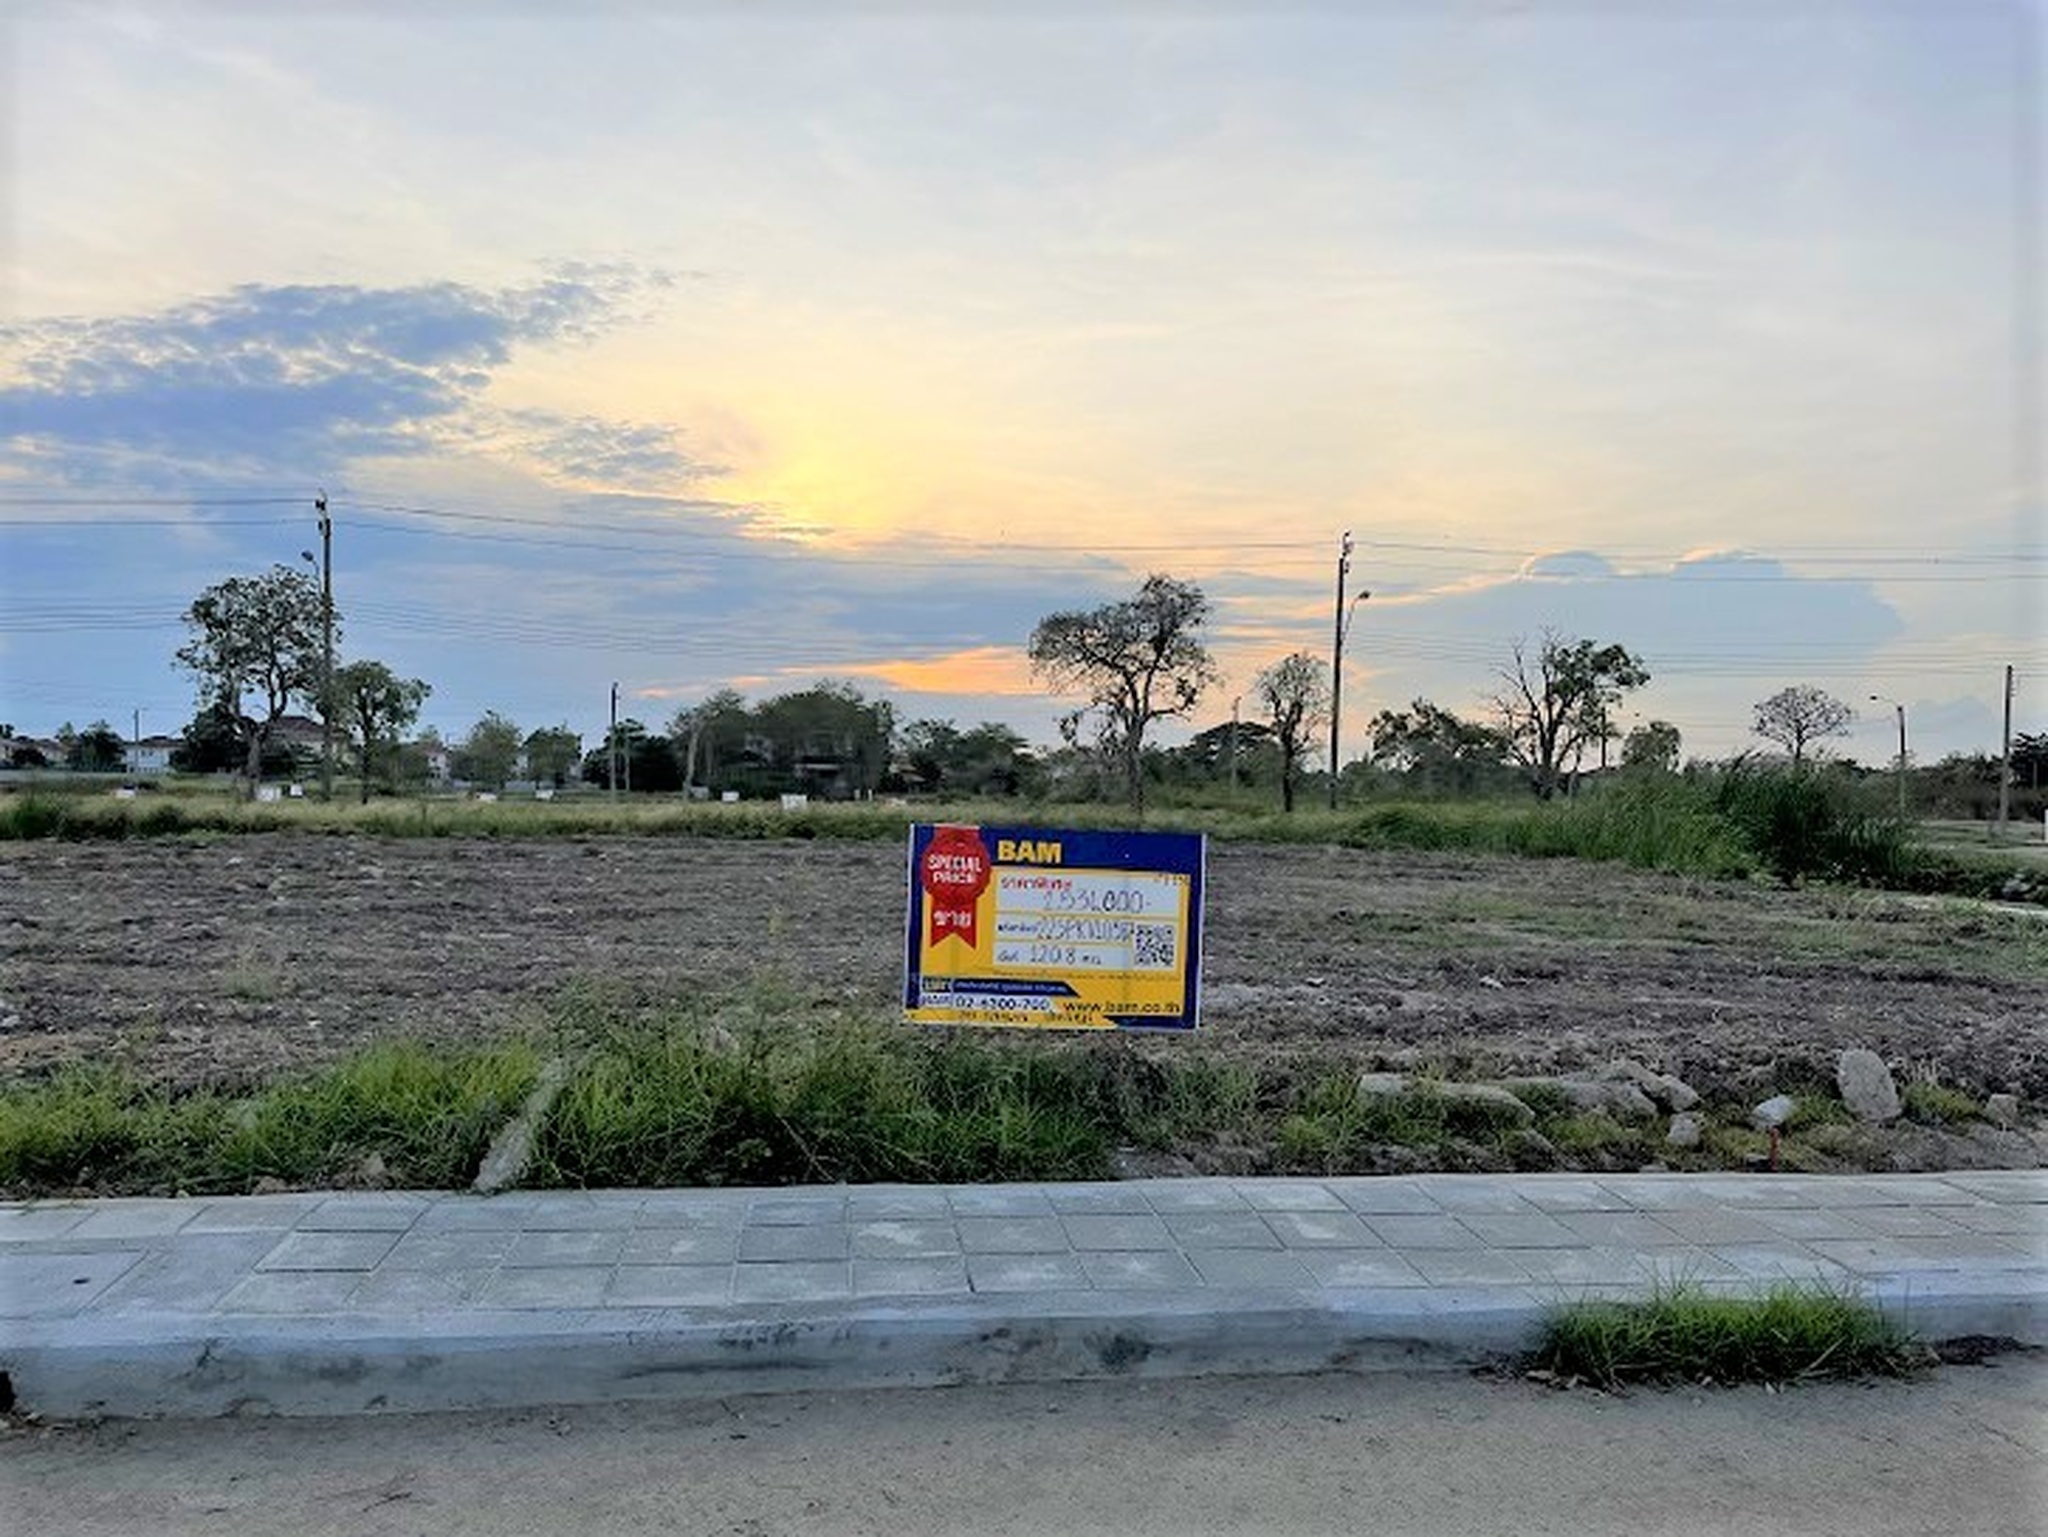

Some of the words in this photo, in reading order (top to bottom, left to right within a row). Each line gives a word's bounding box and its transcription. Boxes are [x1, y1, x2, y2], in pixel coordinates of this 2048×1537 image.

[999, 840, 1062, 863] BAM
[927, 854, 982, 872] SPECIAL
[1063, 1000, 1181, 1014] www.bam.co.th
